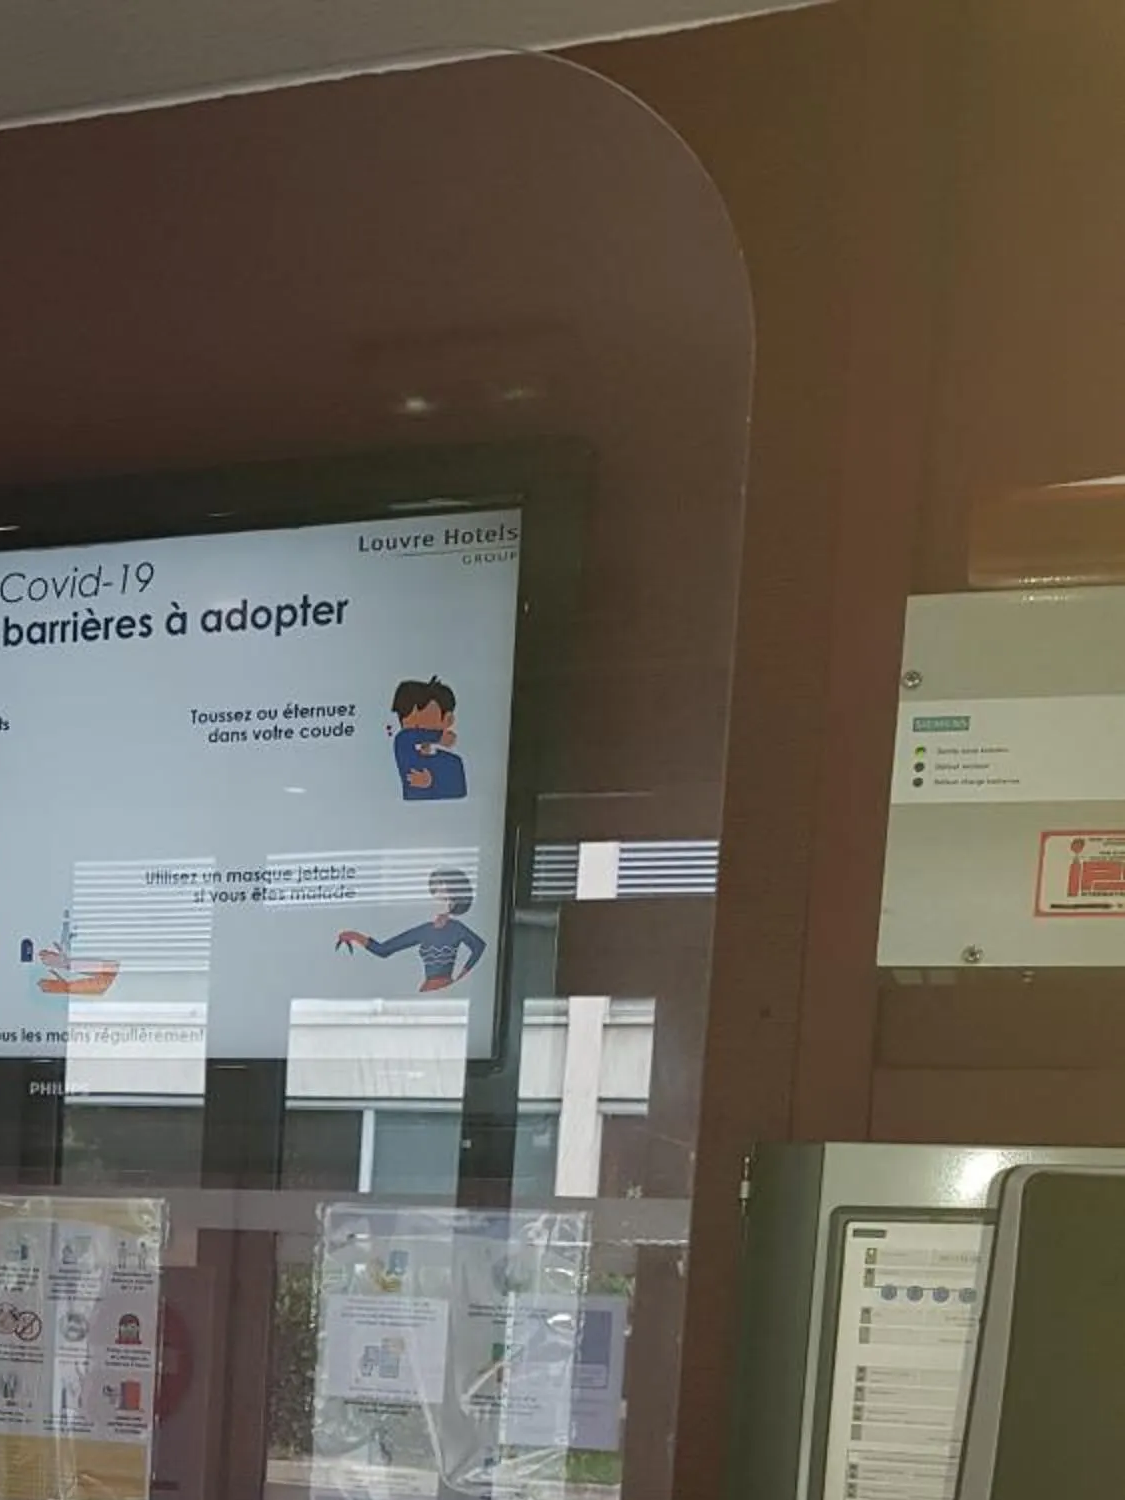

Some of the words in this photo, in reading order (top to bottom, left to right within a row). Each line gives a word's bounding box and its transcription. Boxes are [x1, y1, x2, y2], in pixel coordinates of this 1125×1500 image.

[358, 531, 434, 552] Louvre
[443, 524, 518, 545] Hotels
[462, 551, 518, 565] GROUP
[0, 561, 155, 603] Covid-19
[2, 608, 154, 647] barrières
[165, 602, 187, 635] à
[200, 595, 349, 636] adopter
[190, 709, 252, 724] Toussez
[256, 709, 278, 721] ou
[282, 703, 356, 720] éternuez
[208, 728, 248, 743] dans
[252, 724, 294, 741] votre
[299, 722, 355, 739] coude
[146, 871, 197, 885] Utilisez
[203, 871, 222, 883] un
[226, 868, 293, 885] masque
[297, 865, 356, 883] jetable
[193, 889, 205, 903] si
[209, 889, 246, 903] vous
[251, 886, 286, 901] êtes
[290, 885, 357, 900] malade
[21, 1028, 43, 1043] les
[46, 1028, 92, 1043] mains
[94, 1027, 204, 1048] régulièrement
